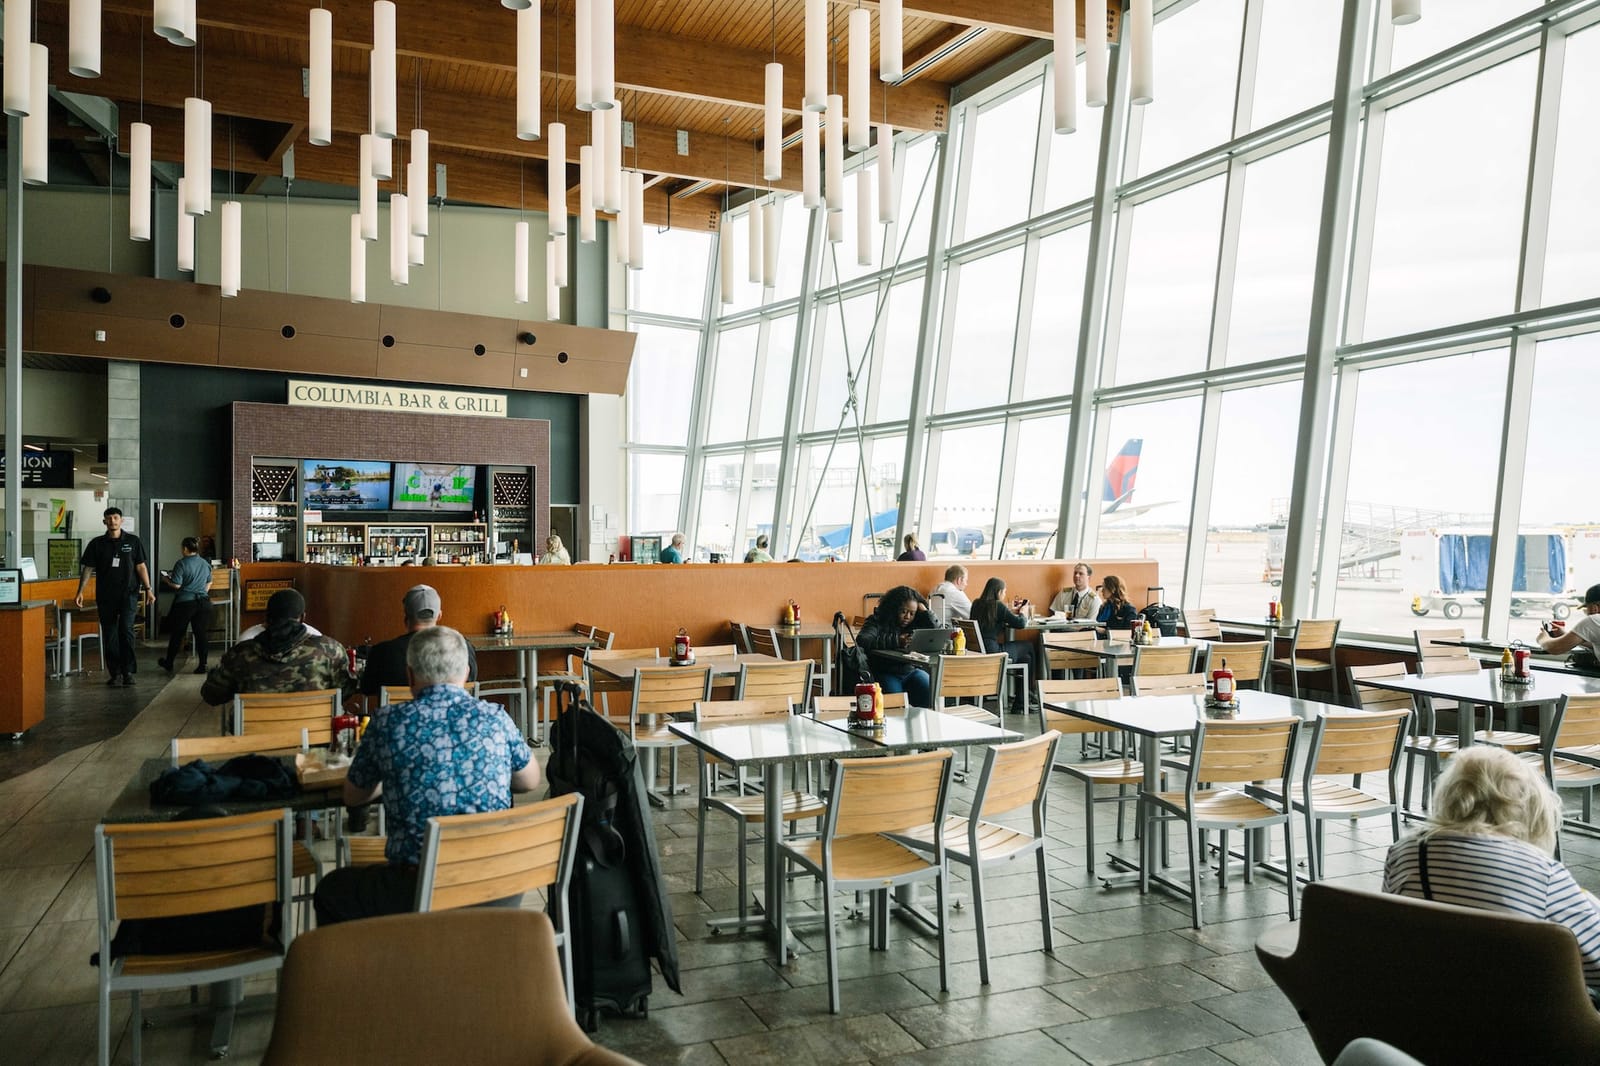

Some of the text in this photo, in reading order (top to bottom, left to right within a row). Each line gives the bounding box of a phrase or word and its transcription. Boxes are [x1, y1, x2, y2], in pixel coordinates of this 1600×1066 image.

[295, 385, 502, 413] COLUMBIA BAR & GRILL
